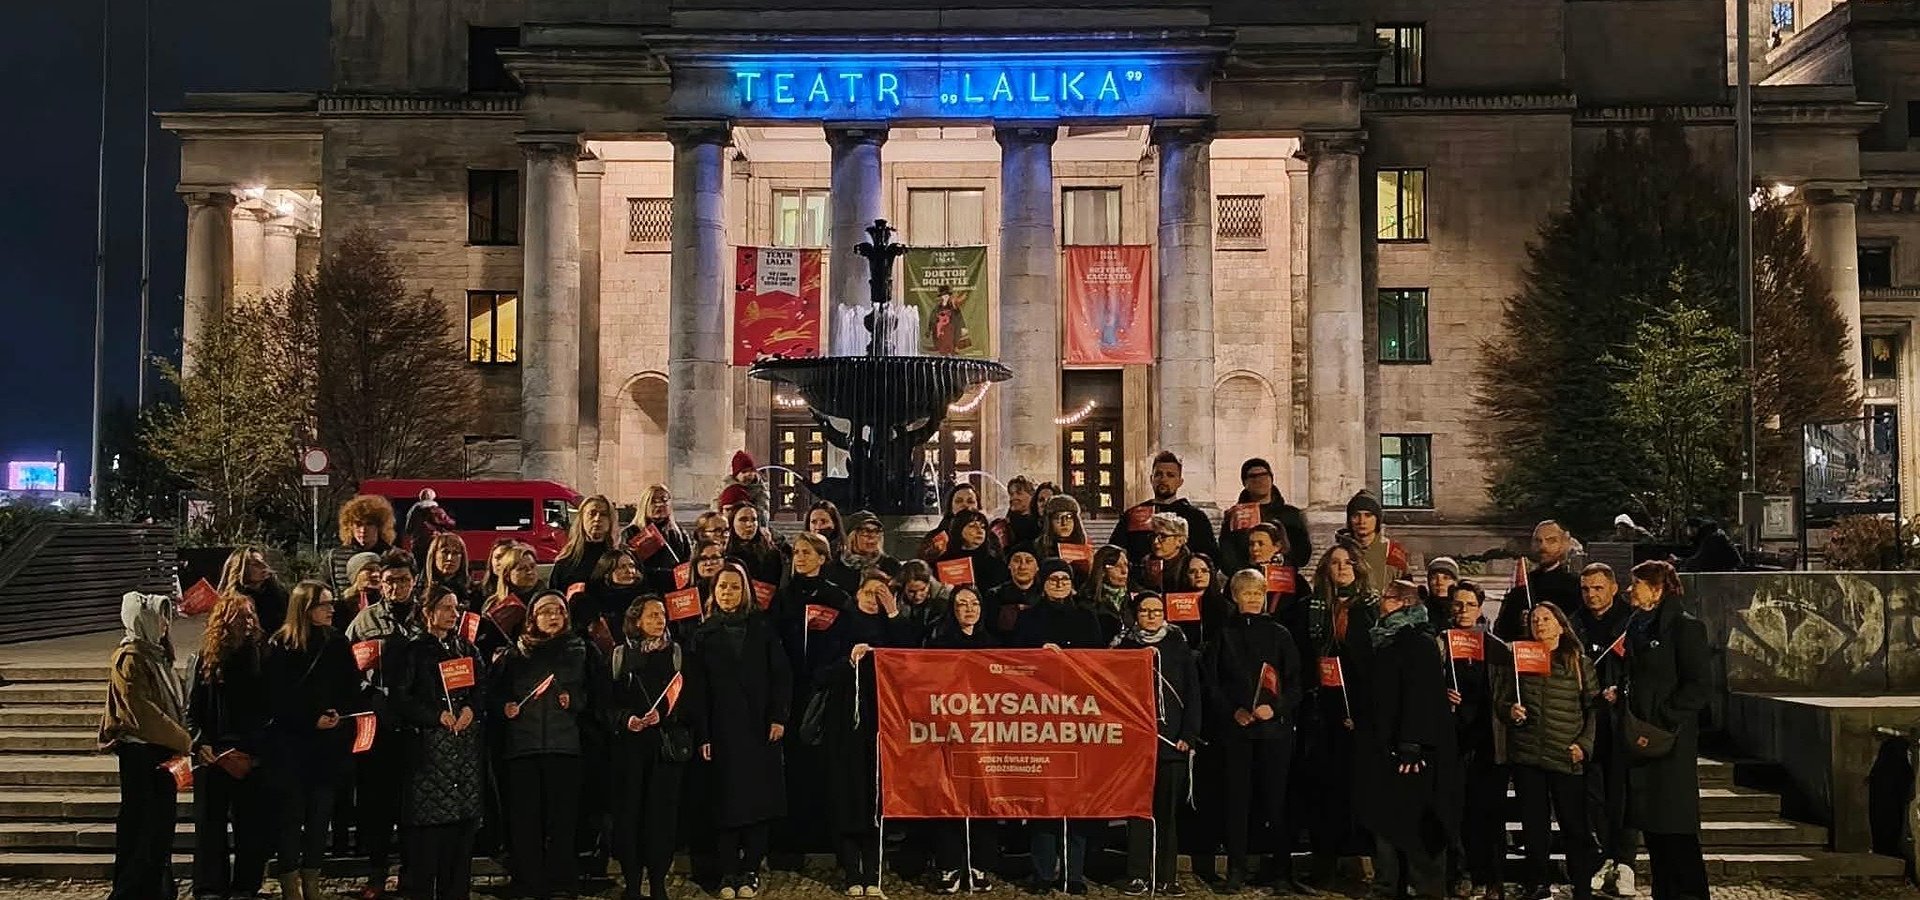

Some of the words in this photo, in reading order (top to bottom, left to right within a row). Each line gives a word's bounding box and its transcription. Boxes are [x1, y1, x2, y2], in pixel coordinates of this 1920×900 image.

[736, 72, 900, 106] TEATR
[922, 278, 969, 286] DOLITTLE
[925, 269, 967, 278] DOKTOR
[930, 693, 1102, 716] KOŁYSANKA
[909, 722, 965, 744] DLA
[970, 722, 1123, 745] ZIMBABWE
